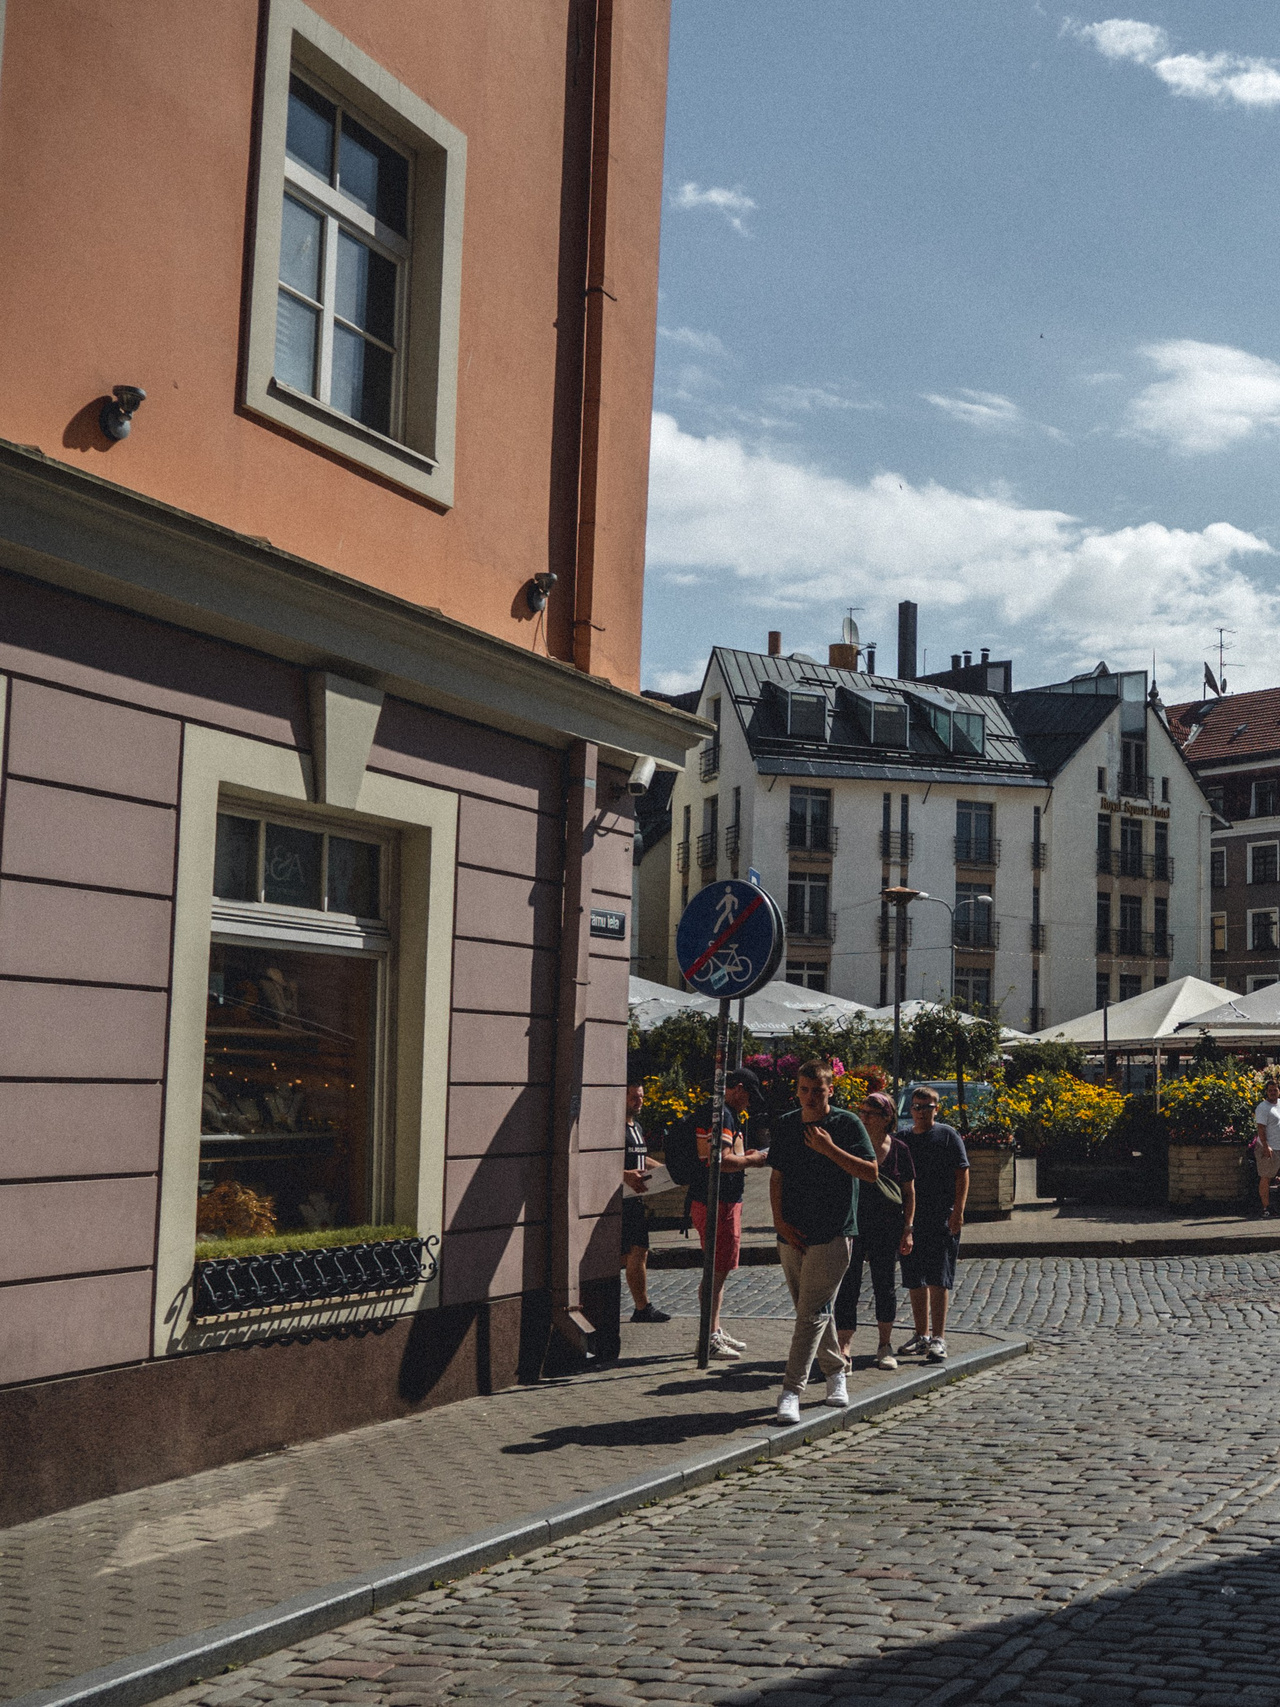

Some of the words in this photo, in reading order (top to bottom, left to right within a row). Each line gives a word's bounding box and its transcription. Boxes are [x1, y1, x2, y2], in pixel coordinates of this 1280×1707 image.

[1101, 797, 1121, 813] Royal
[1124, 801, 1149, 817] Square
[1151, 804, 1170, 819] Hotel
[607, 915, 620, 930] iela
